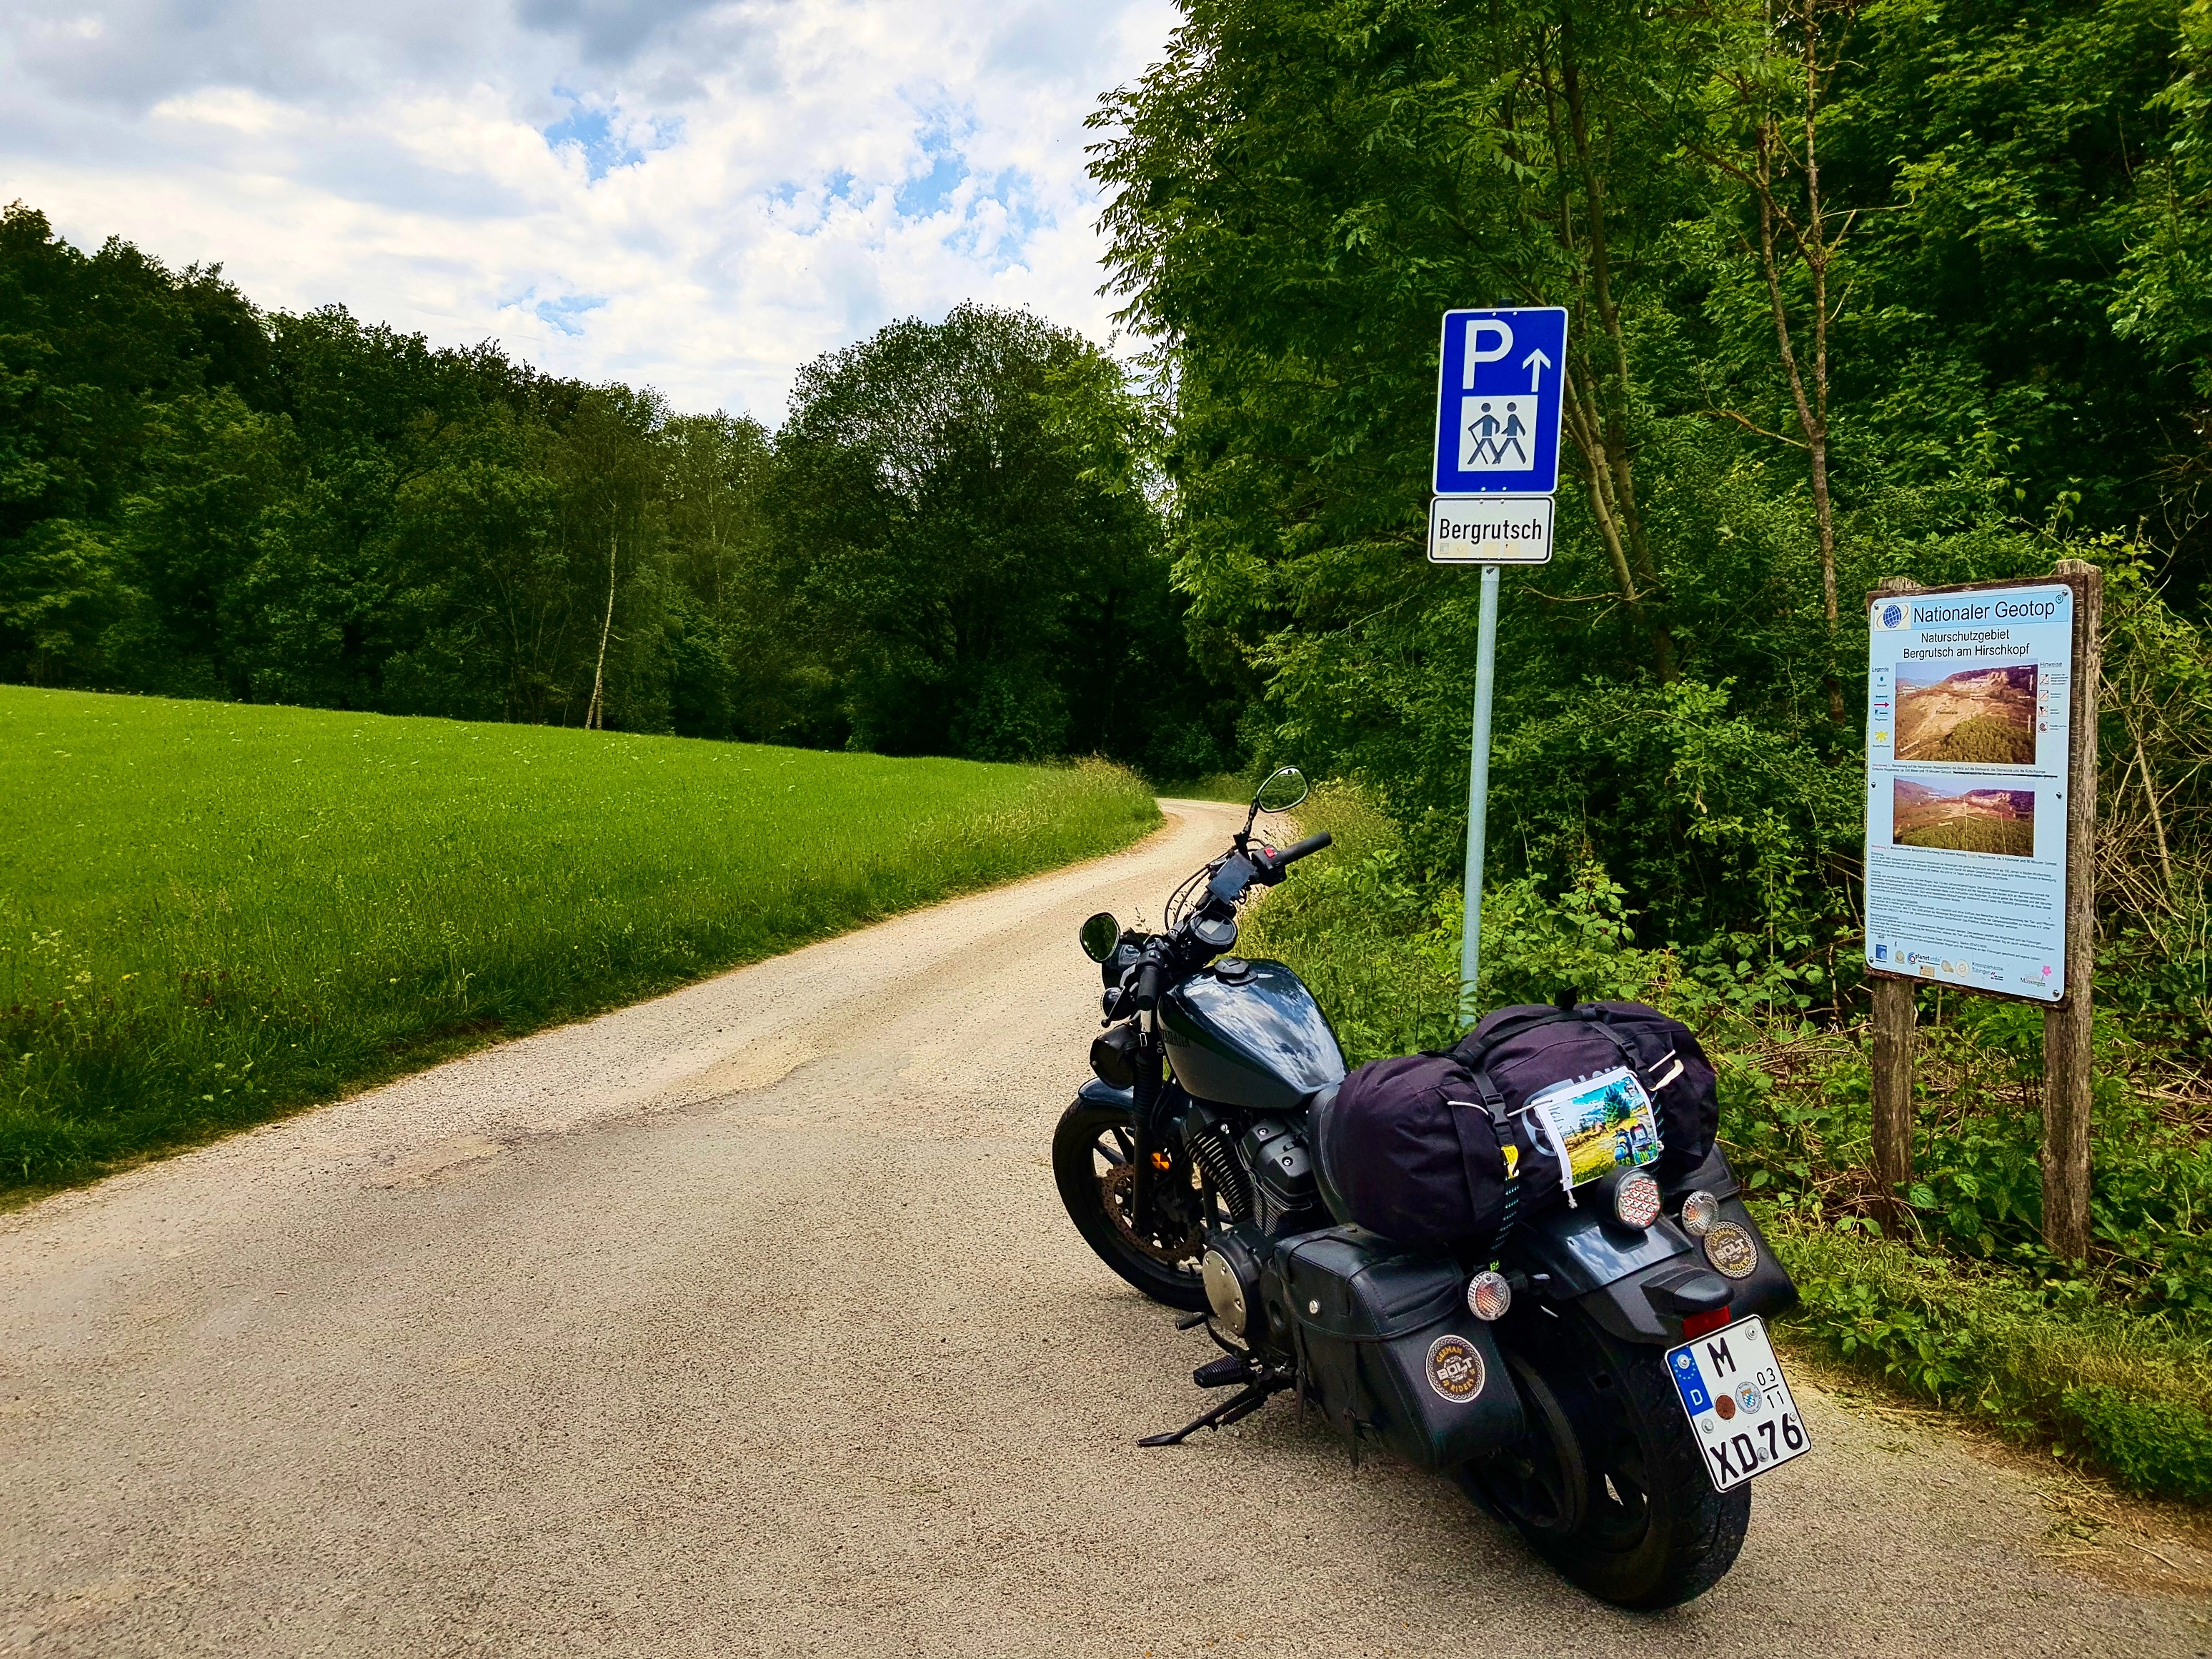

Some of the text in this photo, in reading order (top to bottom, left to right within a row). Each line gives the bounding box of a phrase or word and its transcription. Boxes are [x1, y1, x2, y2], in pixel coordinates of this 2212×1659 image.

[1462, 319, 1514, 389] P
[1439, 518, 1543, 545] Bergrutsch
[1913, 603, 1991, 623] Nationaler
[1995, 600, 2055, 619] Geotop
[1921, 629, 2010, 643] Naturschutzgebiet
[1903, 643, 2031, 660] Bergrutsch am Hirschkopf
[1711, 1229, 1736, 1247] GERMAN
[1715, 1239, 1745, 1260] BOLT
[1729, 1255, 1750, 1270] RIDERS
[1436, 1345, 1463, 1363] GERMAN
[1706, 1337, 1737, 1377] M
[1436, 1357, 1473, 1380] BOLT
[1756, 1367, 1776, 1386] 03
[1450, 1377, 1475, 1393] RIDERS
[1690, 1389, 1703, 1406] D
[1766, 1391, 1785, 1409] 11
[1709, 1413, 1804, 1485] XD 76
